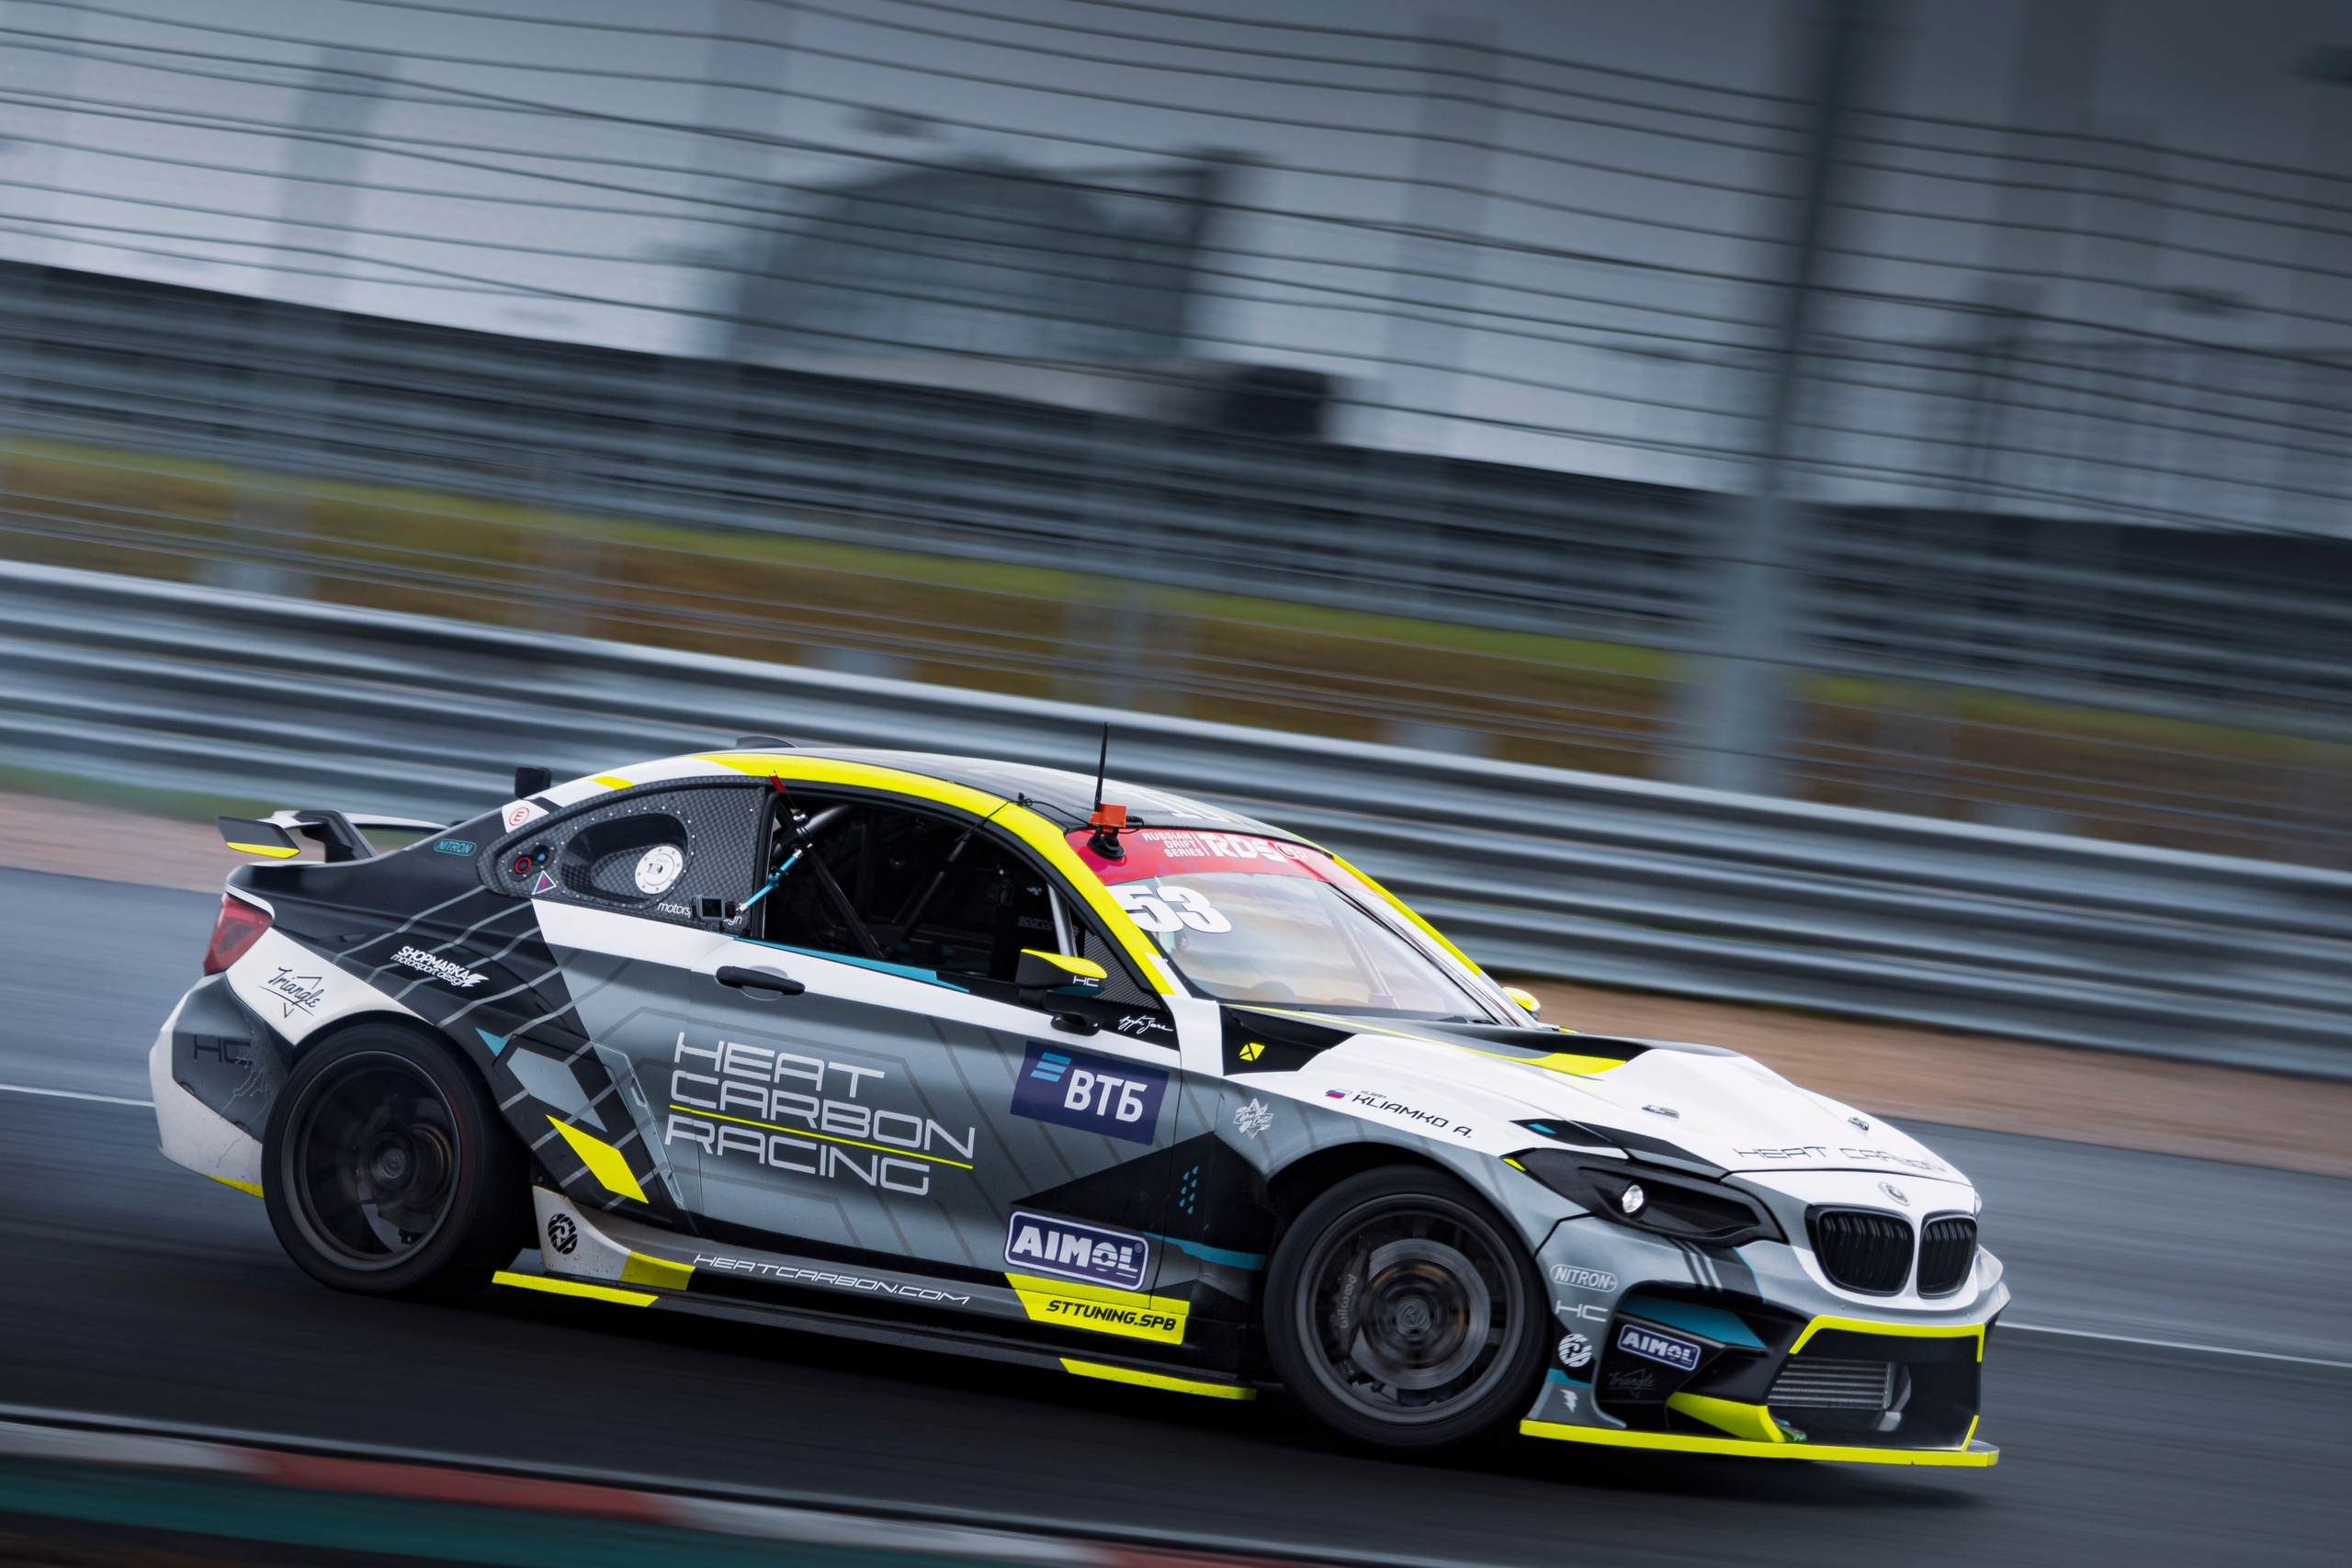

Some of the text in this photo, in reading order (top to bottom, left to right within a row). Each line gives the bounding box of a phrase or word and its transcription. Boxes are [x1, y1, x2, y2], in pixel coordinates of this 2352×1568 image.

[436, 840, 473, 855] NITRON
[1141, 831, 1196, 842] RUSSIAN
[1163, 848, 1205, 858] SERIES
[1164, 840, 1197, 850] DRIFT
[1103, 885, 1232, 933] 53
[390, 953, 439, 976] motorsport
[397, 945, 470, 980] SHOPMARKA
[267, 966, 324, 1009] Triangle
[1072, 975, 1101, 987] HC
[673, 1032, 885, 1099] HEAT
[1064, 1069, 1145, 1123] ВТБ
[670, 1069, 976, 1159] CARBON
[1351, 1093, 1449, 1128] KLIAMKO
[1453, 1126, 1473, 1139] A.
[664, 1113, 931, 1196] RACING
[1732, 1145, 1827, 1159] HEAT
[1012, 1225, 1138, 1275] AIMOL
[693, 1253, 970, 1305] HEATCARBON.COM
[1555, 1267, 1610, 1290] NITRON
[1046, 1299, 1177, 1332] STTUNING.SPB
[1555, 1300, 1609, 1323] HC
[1622, 1330, 1693, 1363] AIMOL
